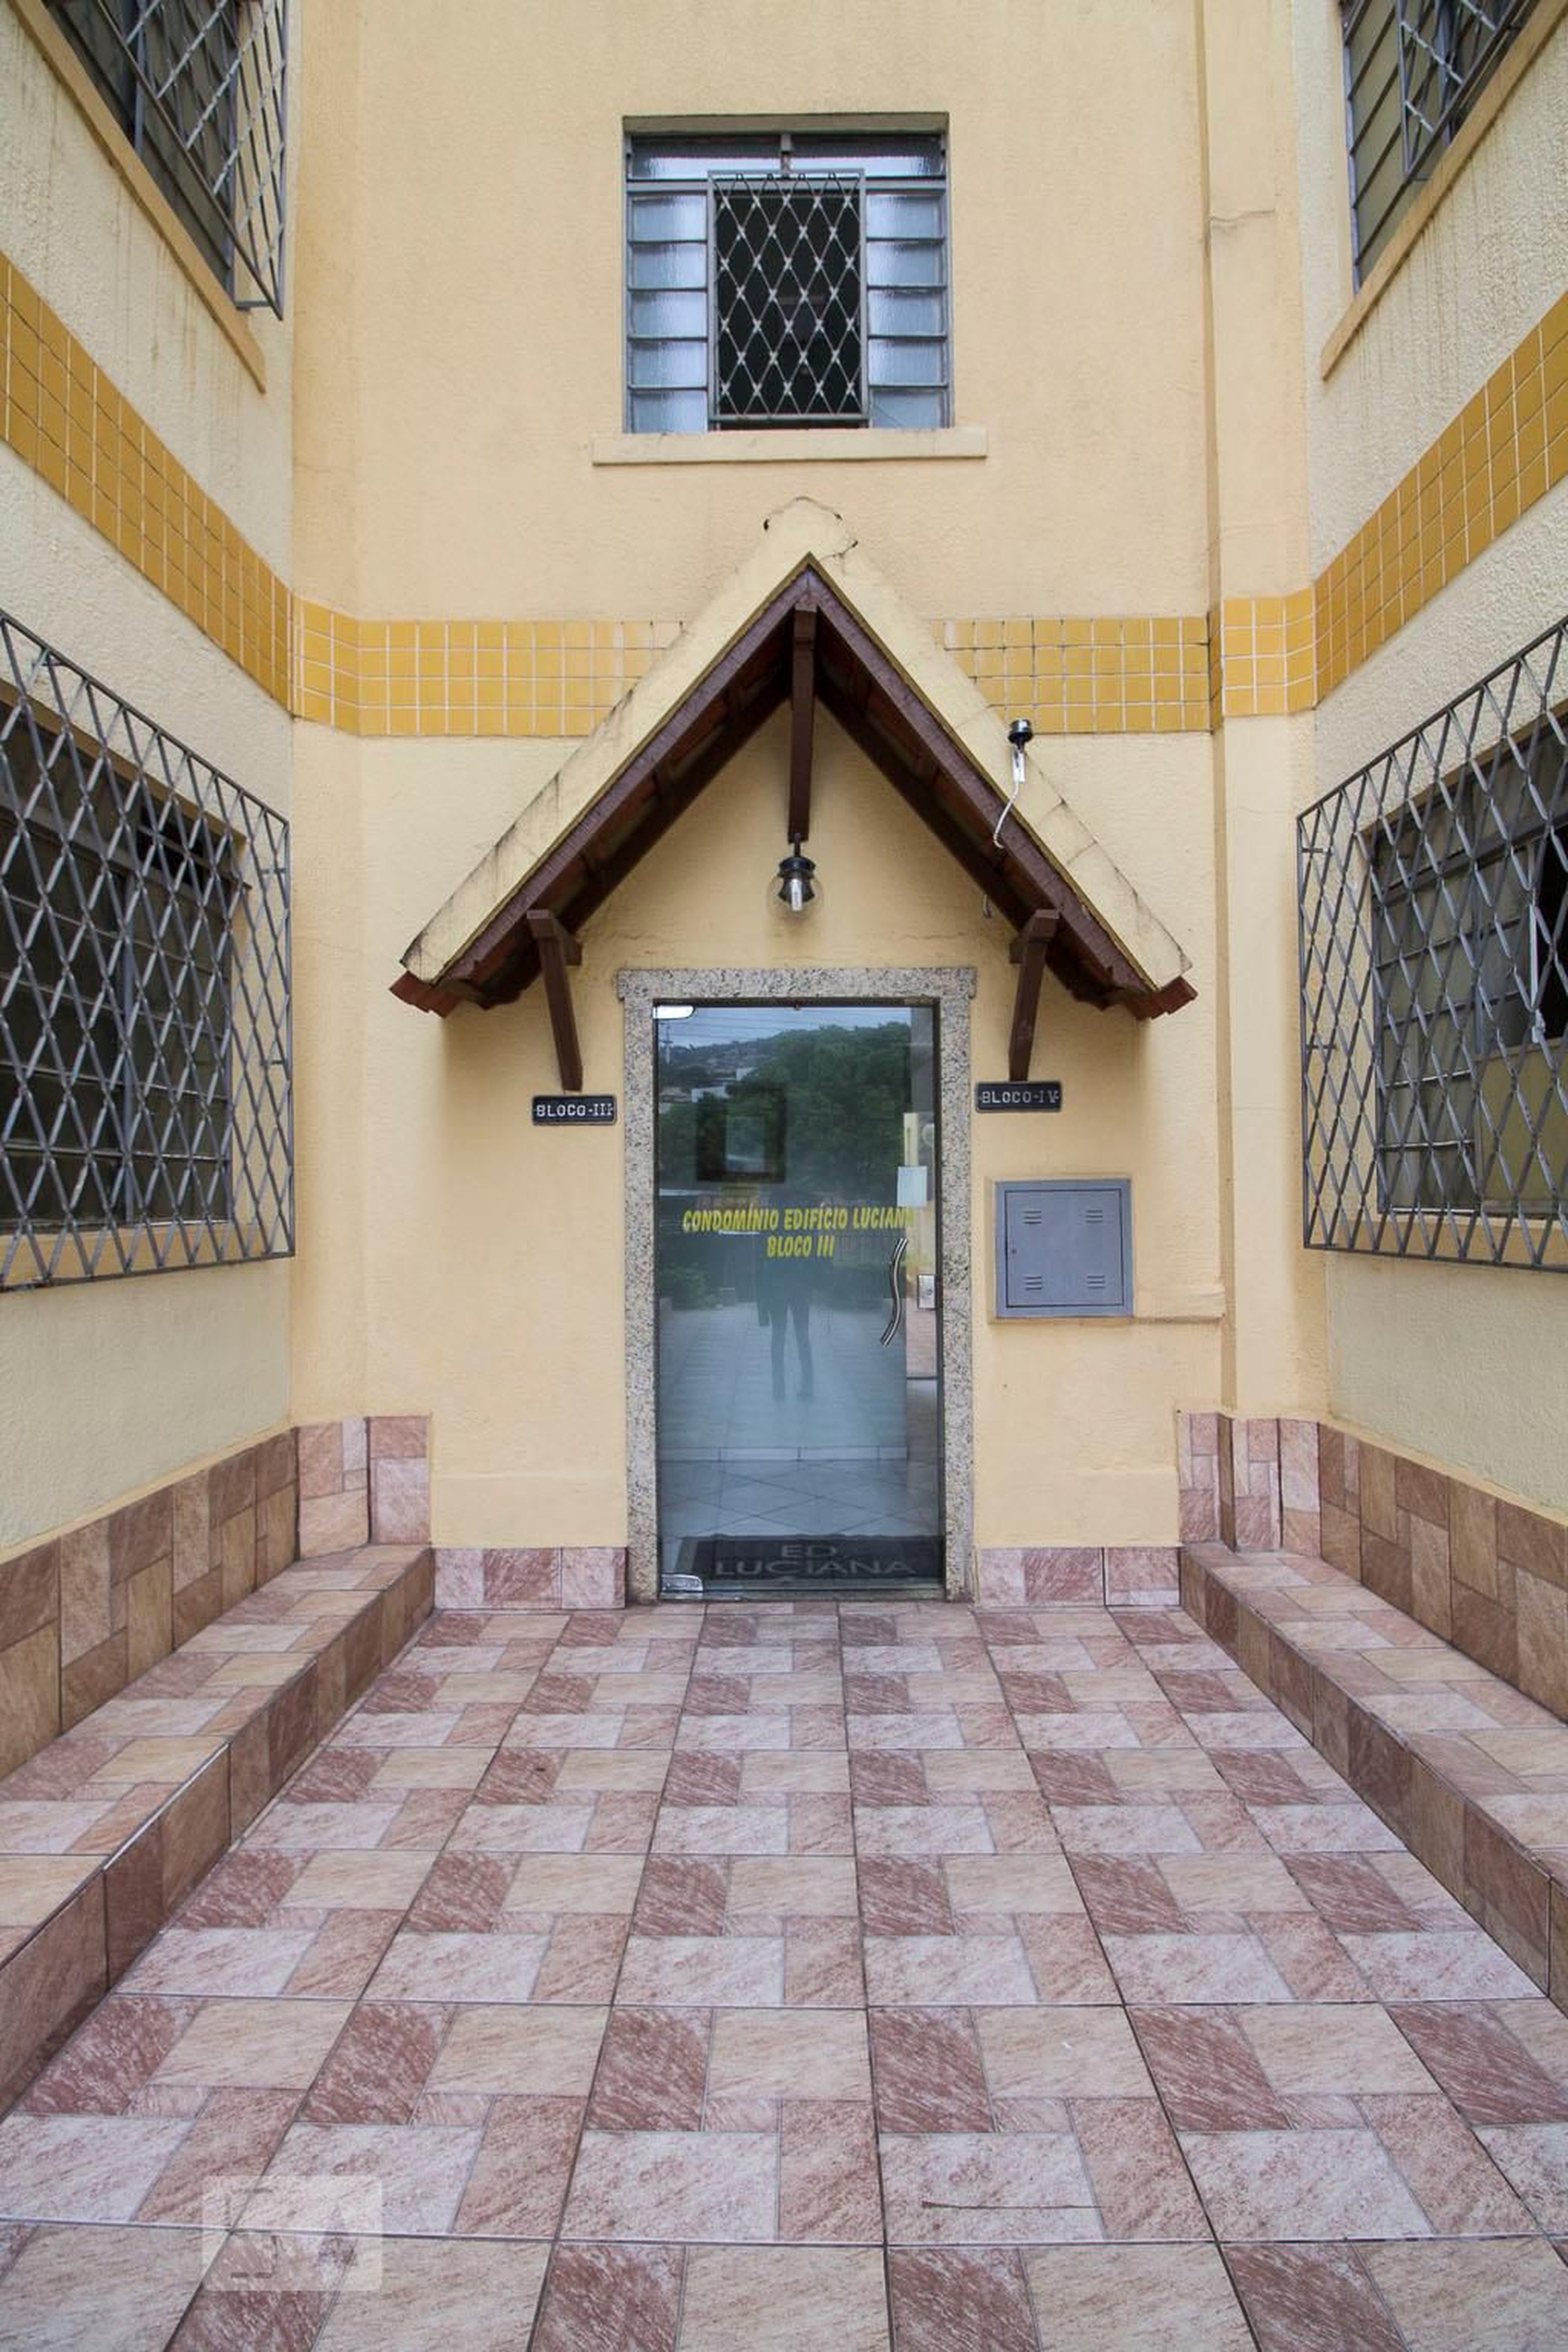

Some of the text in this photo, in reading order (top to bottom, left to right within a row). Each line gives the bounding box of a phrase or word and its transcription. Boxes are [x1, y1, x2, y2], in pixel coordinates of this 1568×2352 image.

[982, 1089, 1058, 1103] BLOCO-IV
[683, 1202, 779, 1233] CONDOMÍNIO
[784, 1202, 848, 1230] EDIFÍCIO
[767, 1235, 835, 1258] BLOCO III
[781, 1544, 837, 1558] ED
[715, 1560, 917, 1576] LUCIANA
